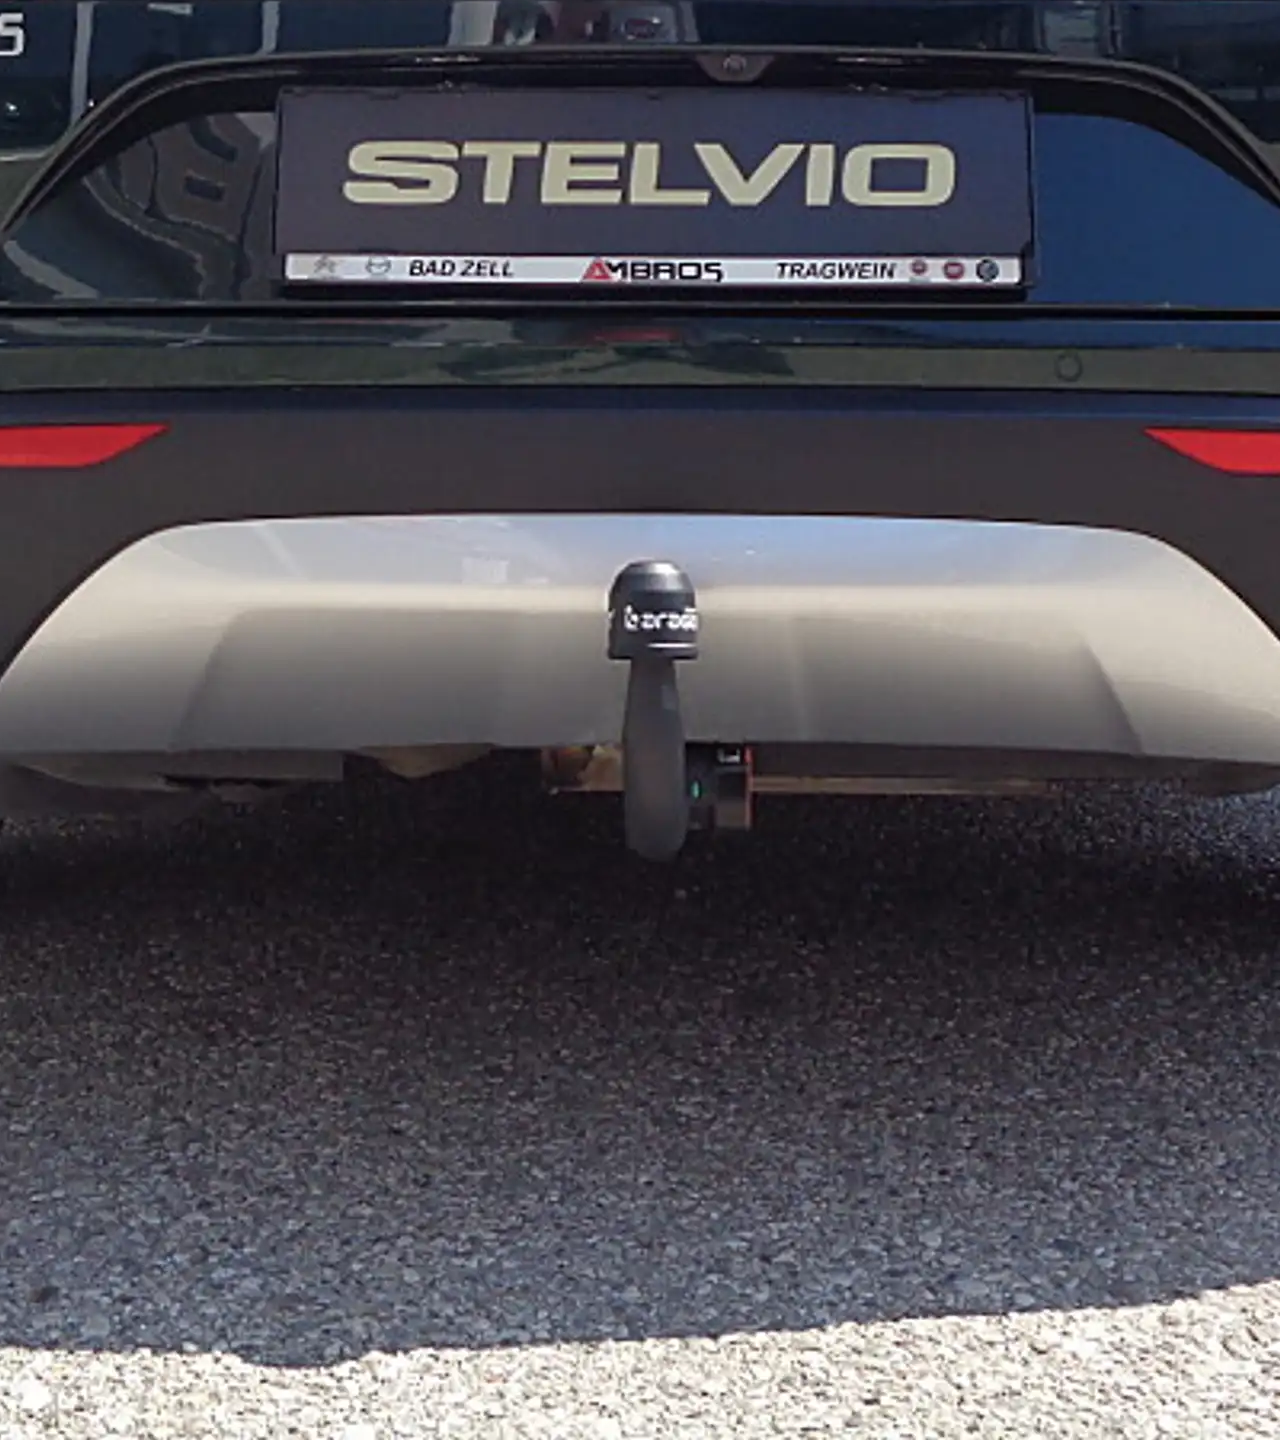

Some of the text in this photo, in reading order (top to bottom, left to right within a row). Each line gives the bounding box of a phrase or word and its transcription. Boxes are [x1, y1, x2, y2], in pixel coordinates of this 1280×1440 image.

[342, 140, 957, 208] STELVIO
[408, 258, 898, 283] BAD ZELL AMBROS TRAGWEIN
